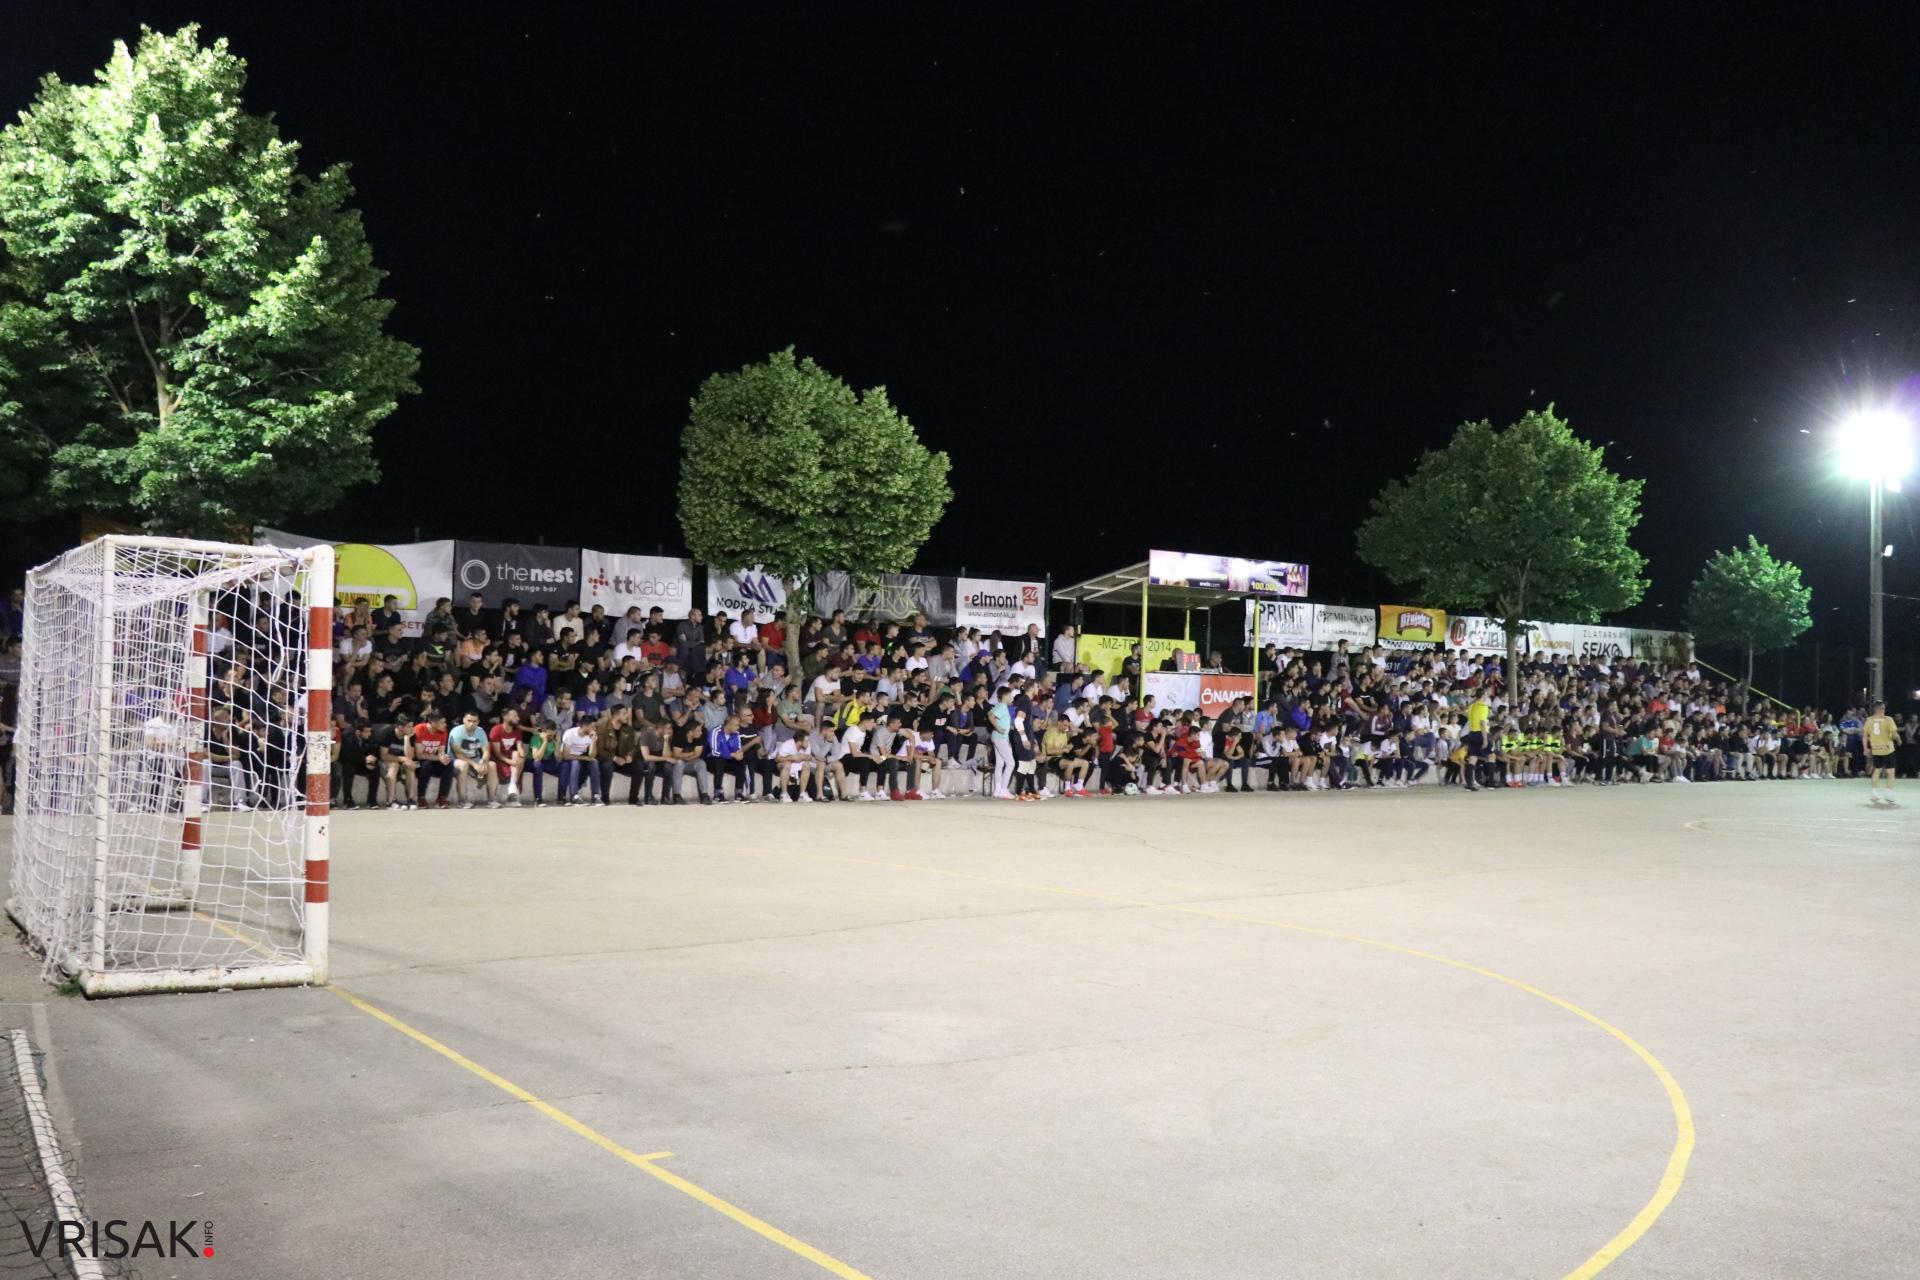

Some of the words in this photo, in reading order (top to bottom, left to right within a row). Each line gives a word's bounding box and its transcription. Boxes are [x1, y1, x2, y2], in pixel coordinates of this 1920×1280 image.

[511, 584, 540, 593] lounge
[543, 584, 557, 593] bar
[716, 597, 756, 613] MODRA
[971, 591, 1018, 609] elmont
